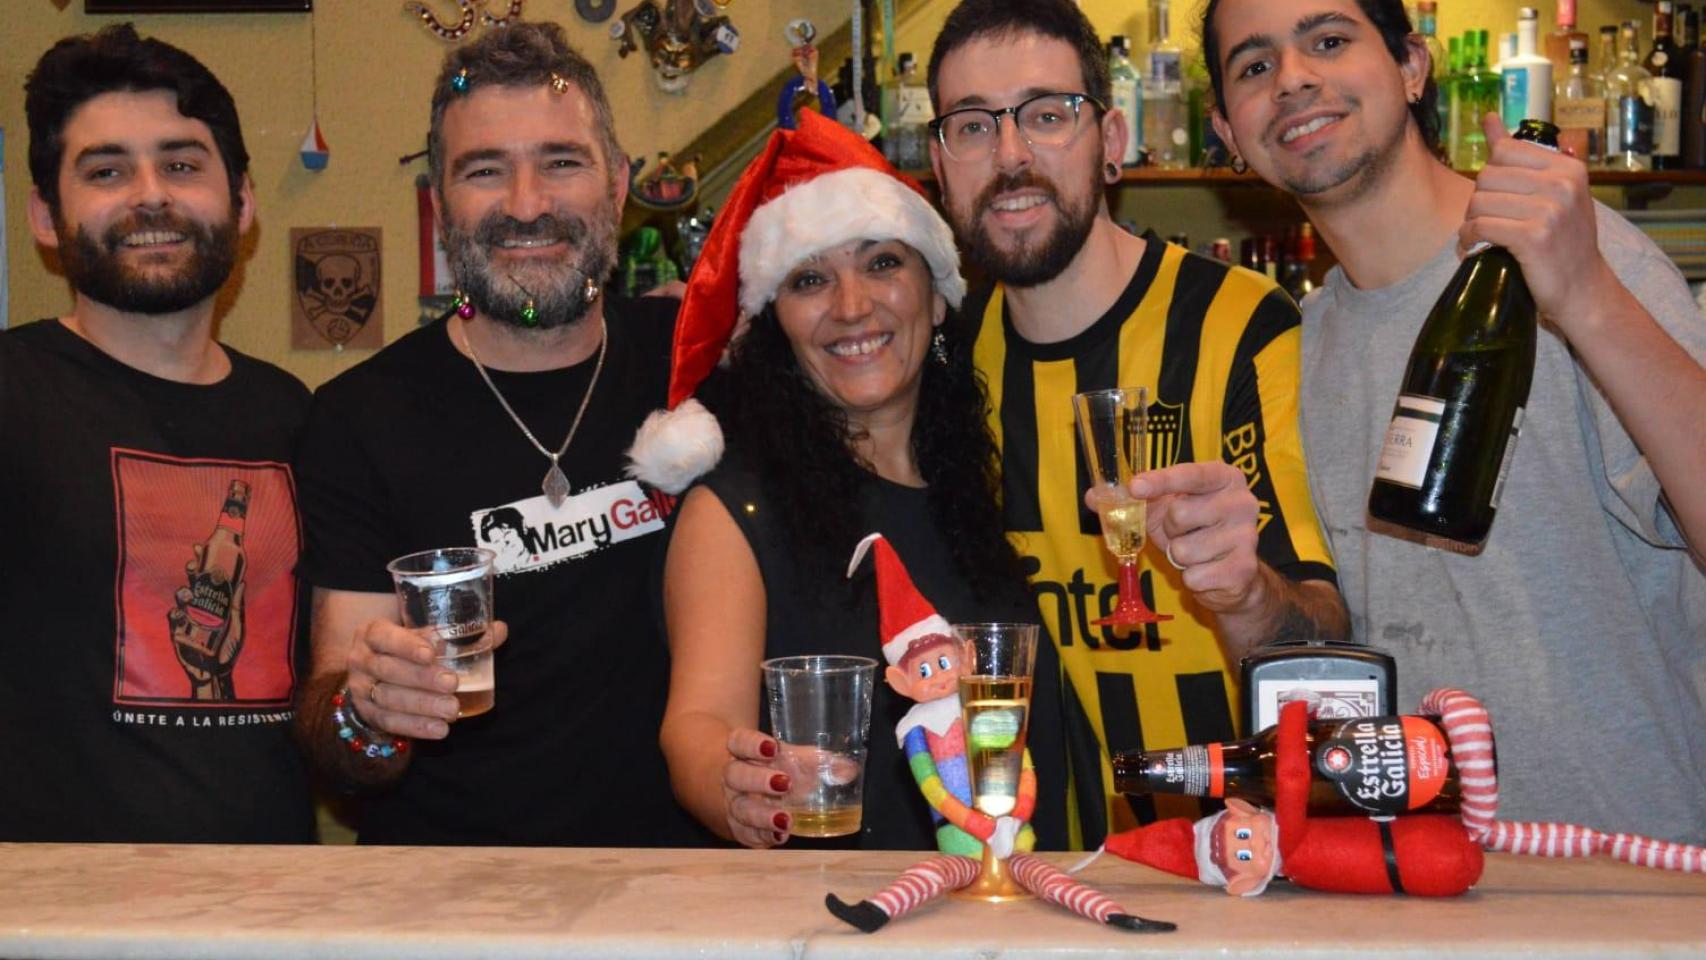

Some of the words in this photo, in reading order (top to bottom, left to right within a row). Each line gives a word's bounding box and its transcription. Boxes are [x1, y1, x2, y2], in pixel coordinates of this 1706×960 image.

[112, 709, 168, 726] ÚNETE
[175, 714, 186, 727] A
[193, 715, 212, 727] LA
[1352, 722, 1382, 801] Estrella
[1377, 723, 1407, 798] Galicia
[1410, 735, 1431, 781] Especial
